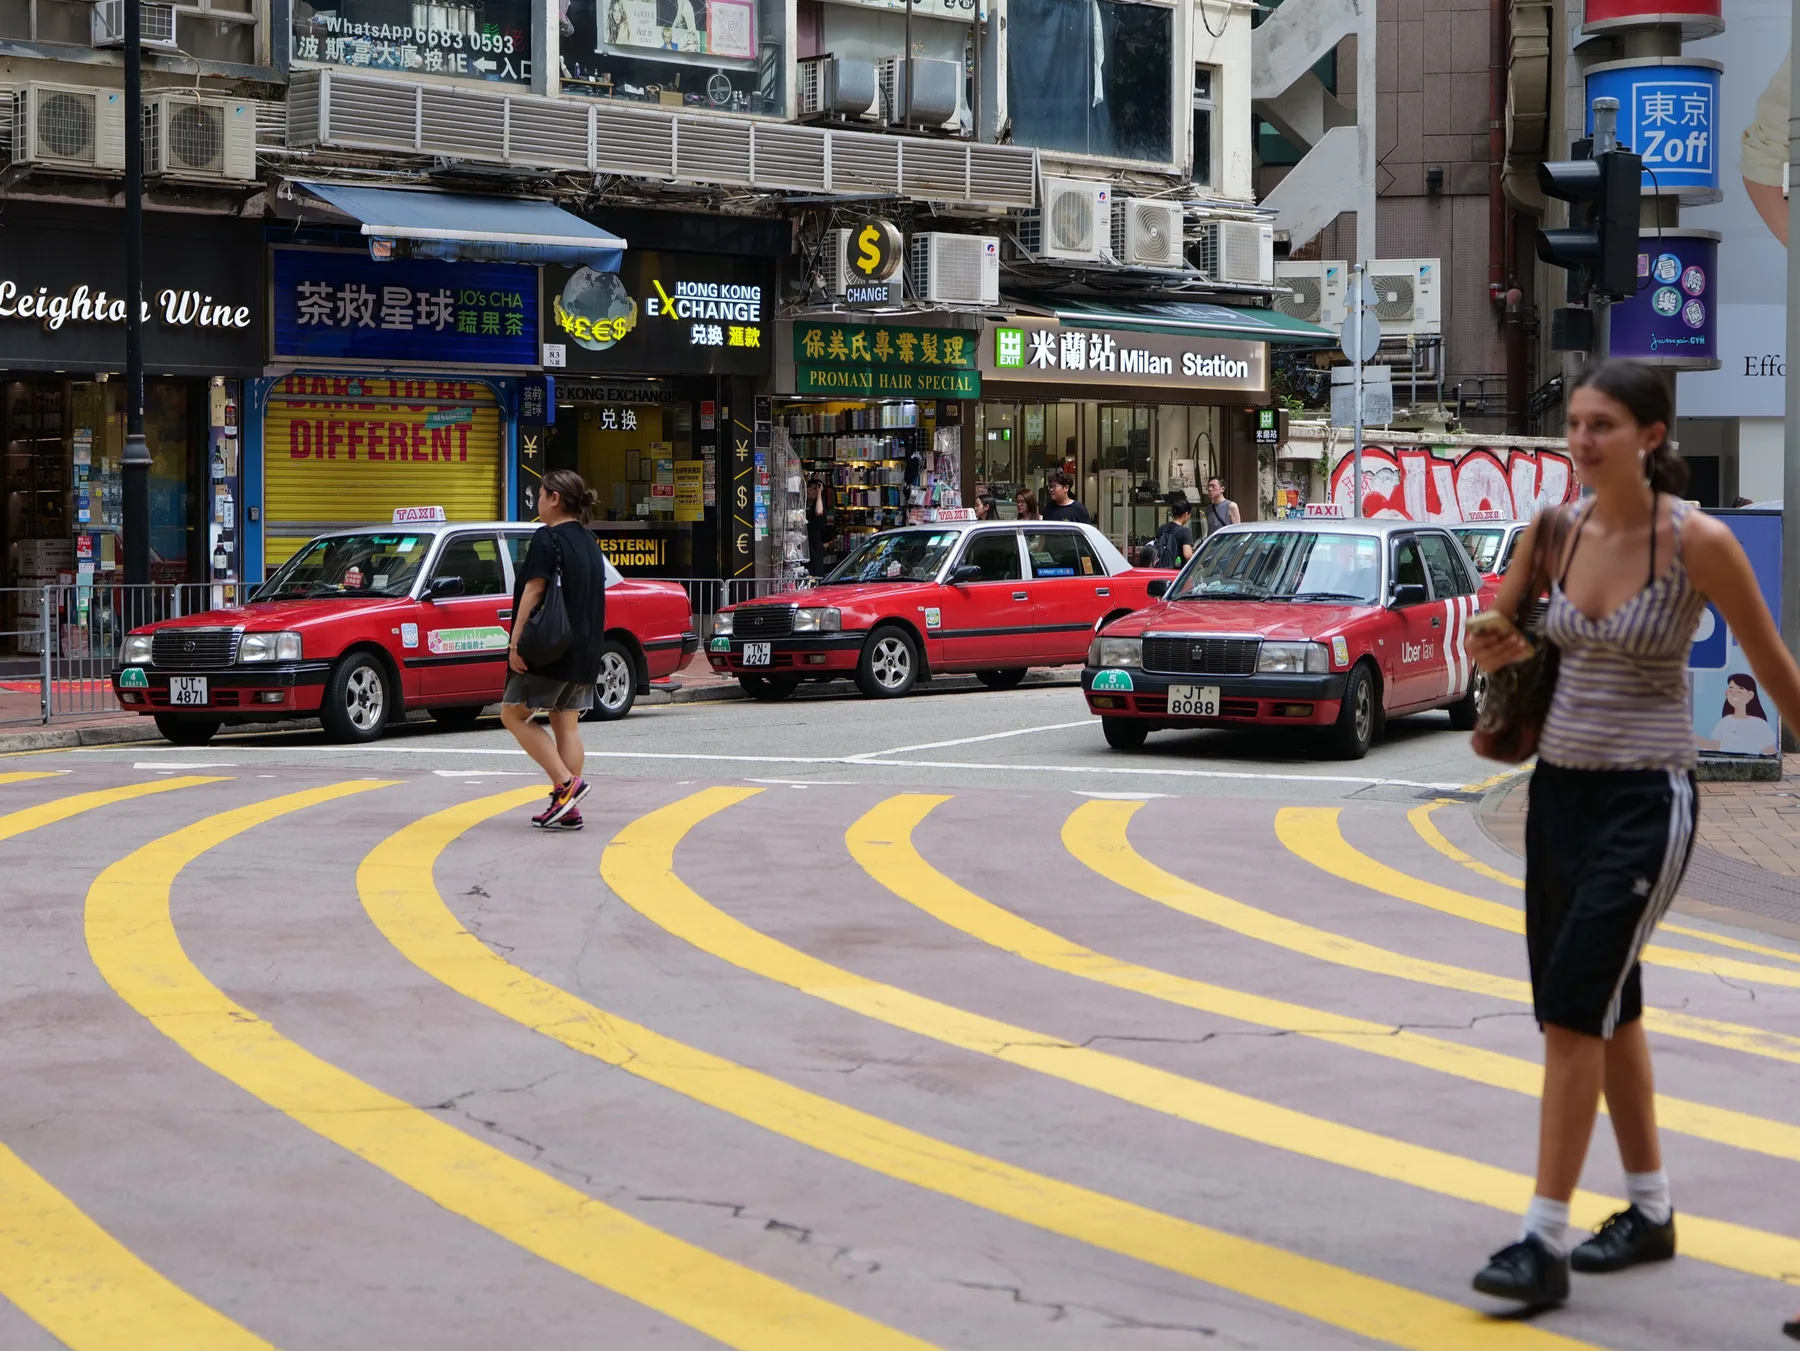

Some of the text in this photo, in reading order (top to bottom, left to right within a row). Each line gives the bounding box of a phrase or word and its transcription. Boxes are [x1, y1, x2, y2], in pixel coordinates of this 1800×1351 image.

[326, 17, 514, 54] WhatsApp 6683 0593
[1641, 91, 1708, 126] 東京
[1641, 130, 1708, 163] Zoff
[856, 225, 881, 274] $
[458, 289, 523, 308] JO's CHA
[676, 281, 761, 300] HONG KONG
[847, 286, 888, 302] CHANGE
[160, 289, 250, 327] Wine
[297, 280, 454, 331] 茶救星球
[646, 279, 761, 322] EXCHANGE
[458, 310, 524, 336] 蔬果茶
[802, 328, 967, 366] 保美氏專業髮理
[1000, 331, 1021, 355] 出
[549, 351, 560, 359] 83
[1000, 355, 1021, 365] EXIT
[1029, 330, 1248, 378] 米蘭站 Milan Station
[810, 370, 972, 392] PROMAXI HAIR SPECIAL
[567, 387, 605, 400] KONG
[289, 420, 473, 462] DIFFERENT
[524, 435, 537, 459] ¥
[736, 440, 748, 461] ¥
[737, 485, 747, 509] $
[396, 507, 435, 521] TAXI
[938, 509, 968, 521] TAXI
[1307, 505, 1338, 516] TAXI
[1468, 511, 1499, 520] TAXI
[596, 539, 654, 551] ESTERN
[736, 533, 749, 554] €
[609, 553, 654, 566] UNION
[752, 644, 763, 654] TN
[1402, 639, 1434, 664] Uber Taxi
[746, 654, 768, 665] 4247
[130, 672, 136, 681] 4
[180, 678, 195, 690] UT
[1109, 675, 1117, 684] 5
[176, 691, 203, 704] 4871
[1183, 687, 1205, 700] JT
[1172, 700, 1214, 715] 8088
